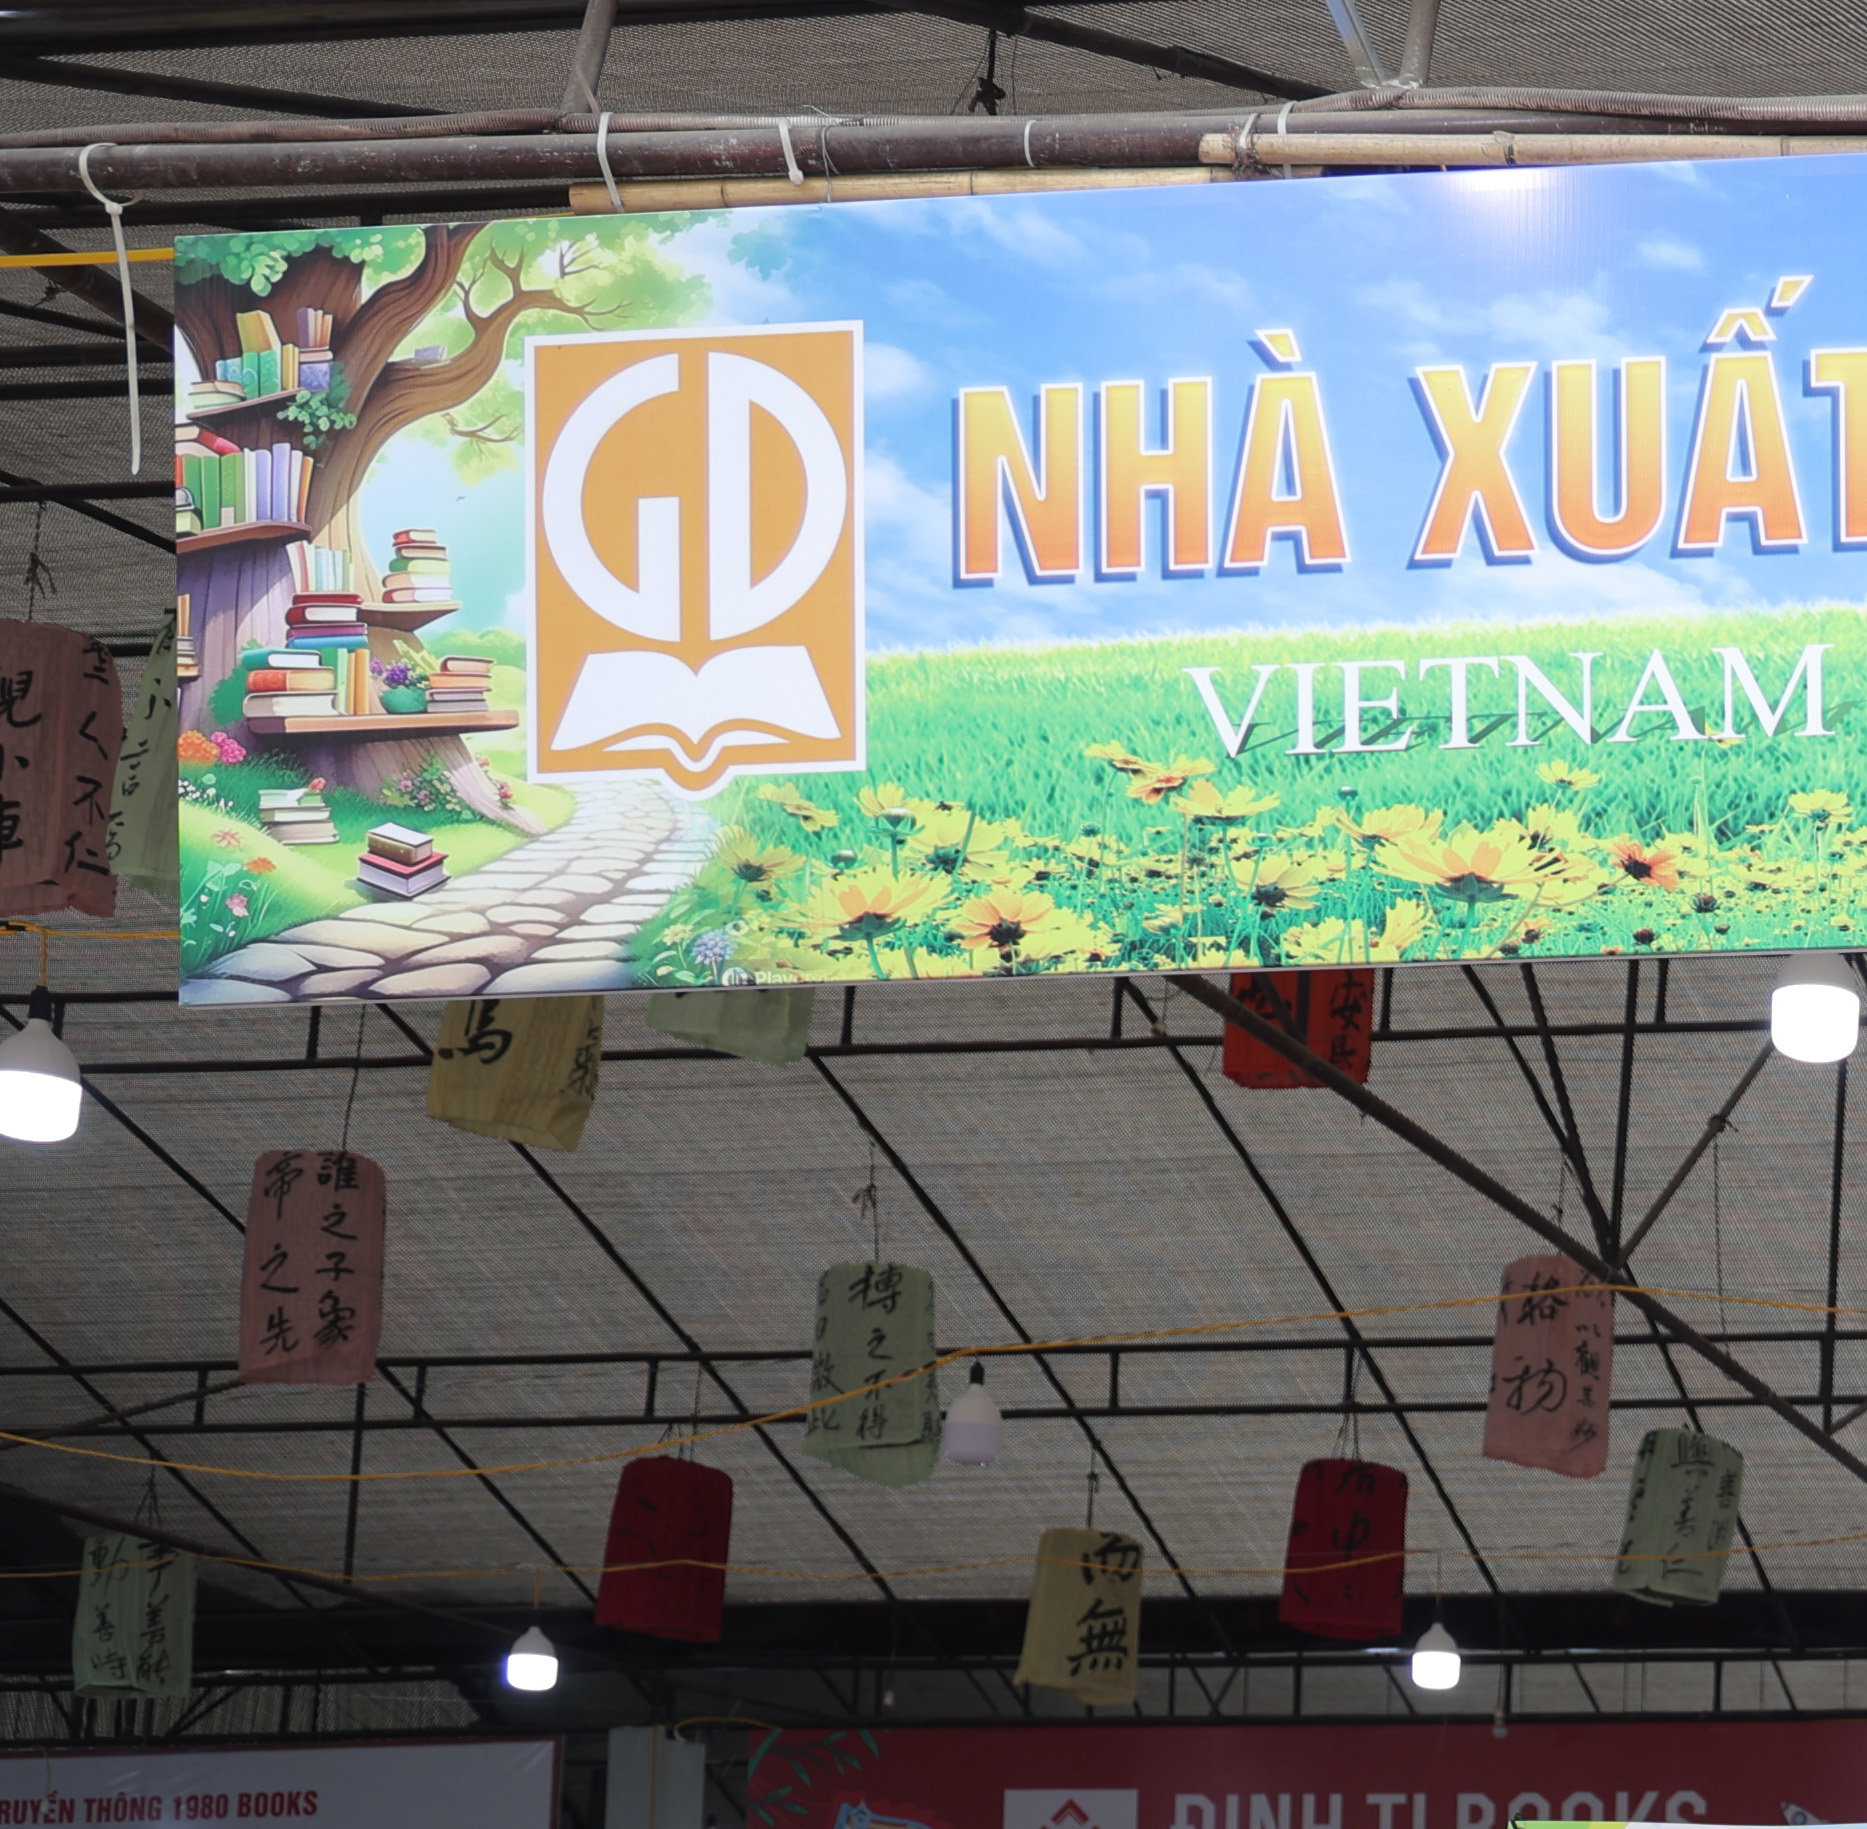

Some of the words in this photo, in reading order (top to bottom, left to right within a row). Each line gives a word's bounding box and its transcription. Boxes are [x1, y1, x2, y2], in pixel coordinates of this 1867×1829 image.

[950, 325, 1350, 585] NHÀ
[1187, 642, 1833, 760] VIETNAM
[84, 1793, 162, 1823] THÔNG
[172, 1792, 229, 1820] 1980
[237, 1790, 318, 1818] BOOKS
